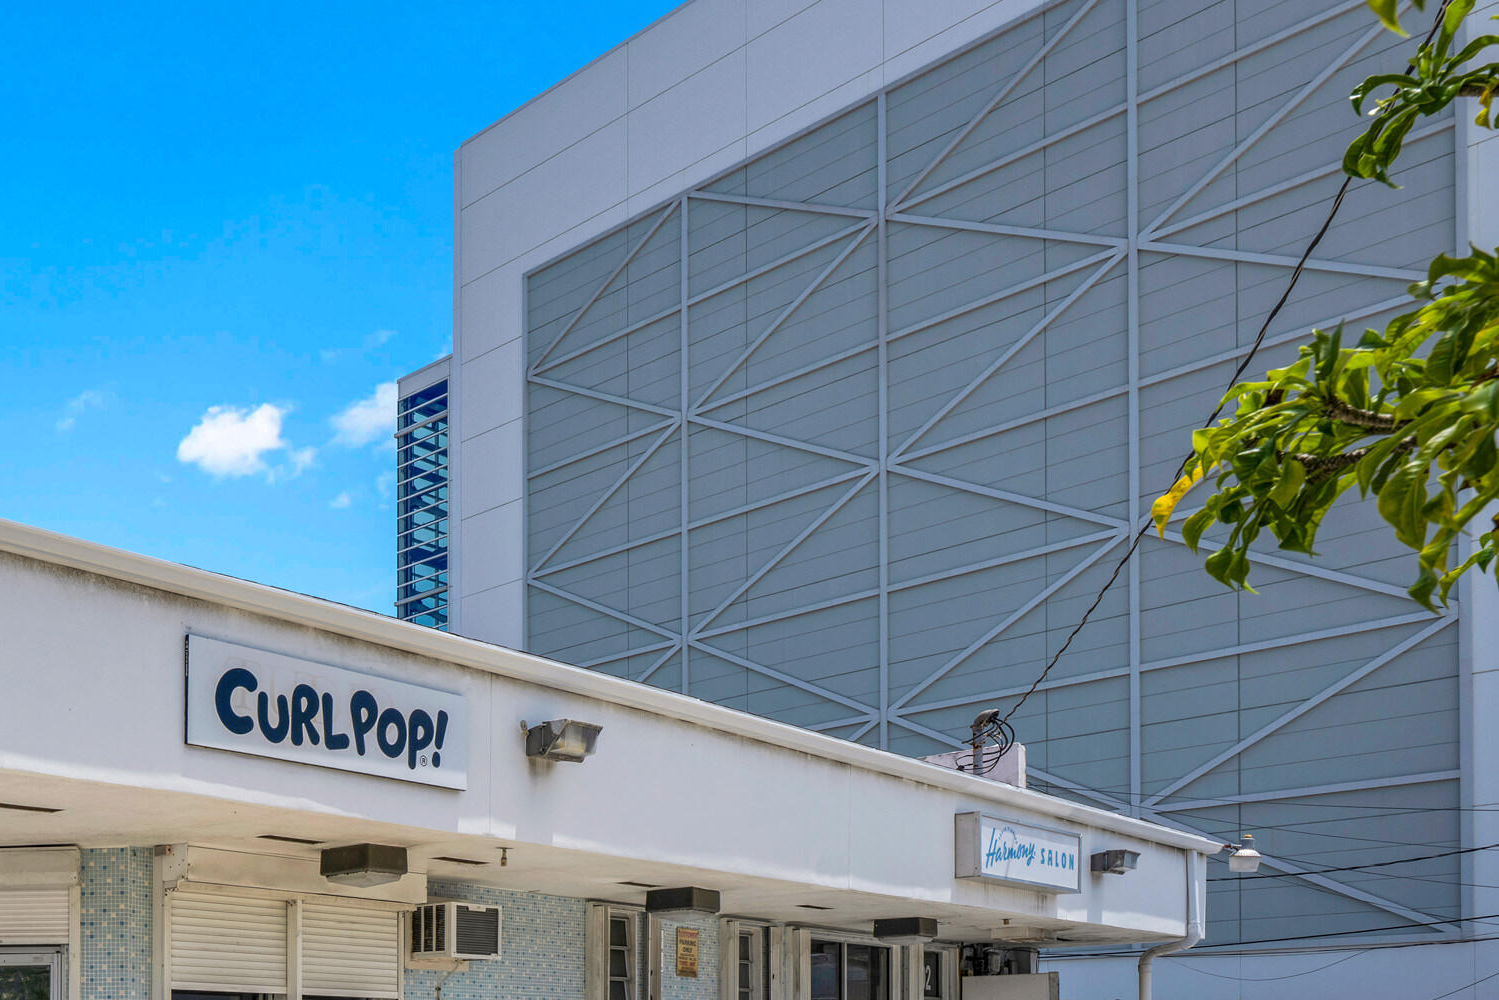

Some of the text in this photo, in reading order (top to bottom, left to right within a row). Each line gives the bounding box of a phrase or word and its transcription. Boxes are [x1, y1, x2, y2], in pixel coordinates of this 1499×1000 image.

[215, 667, 448, 770] CURLPOP!
[985, 827, 1075, 871] Harmony SALON
